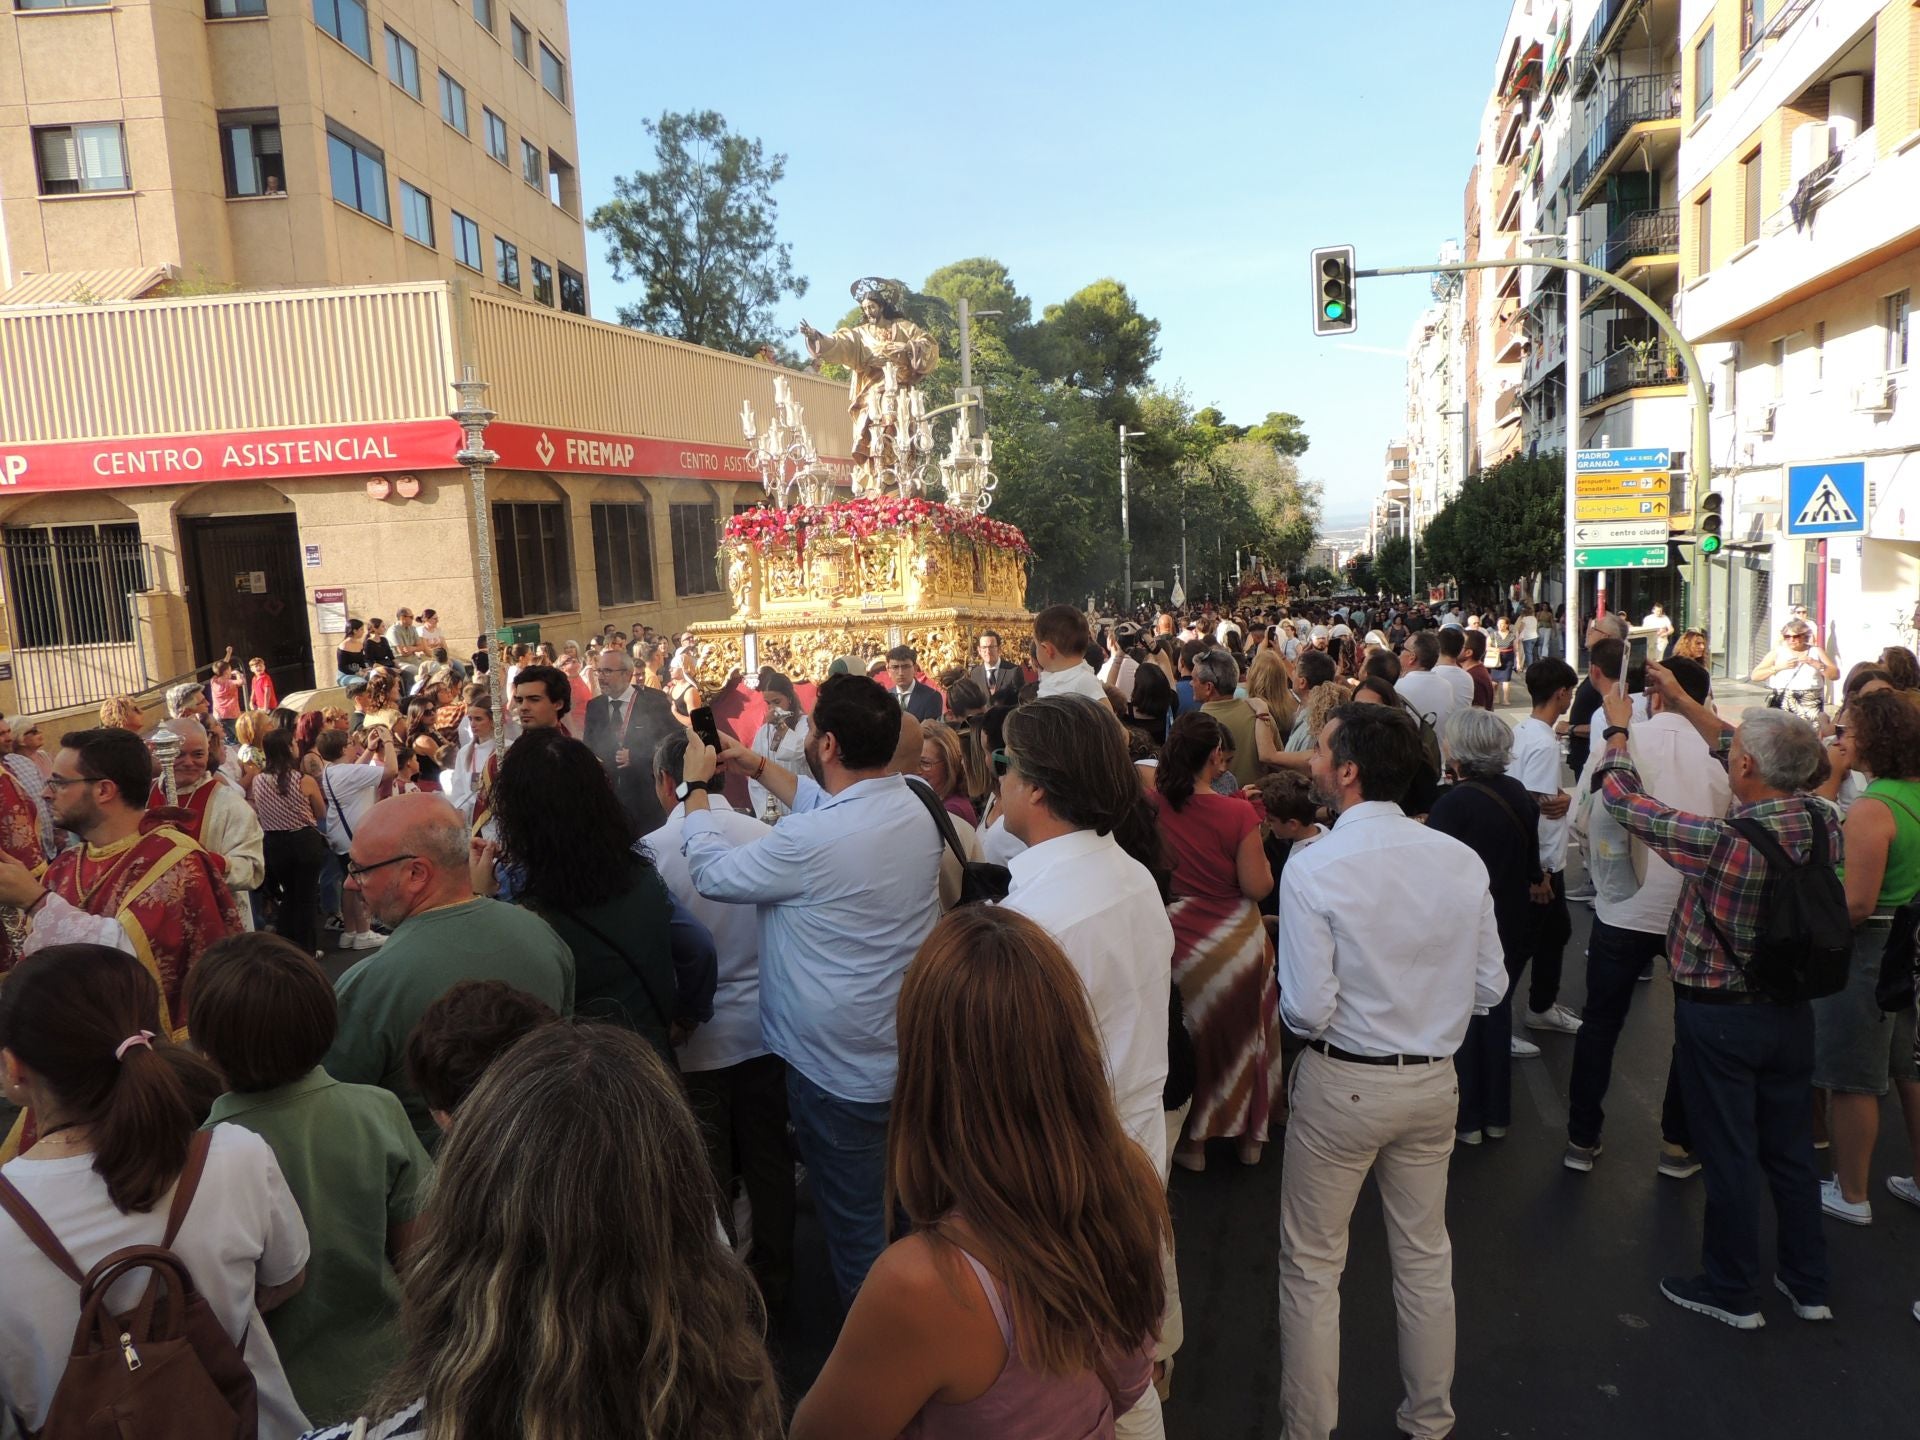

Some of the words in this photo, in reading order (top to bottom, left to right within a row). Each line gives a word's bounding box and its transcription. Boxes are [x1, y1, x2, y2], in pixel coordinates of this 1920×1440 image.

[93, 447, 203, 476] CENTRO
[222, 435, 397, 468] ASISTENCIAL
[566, 438, 635, 468] FREMAP
[1577, 452, 1610, 460] MADRID
[680, 450, 718, 471] CENTRO
[1577, 460, 1620, 468] GRANADA
[1610, 529, 1636, 537] centro
